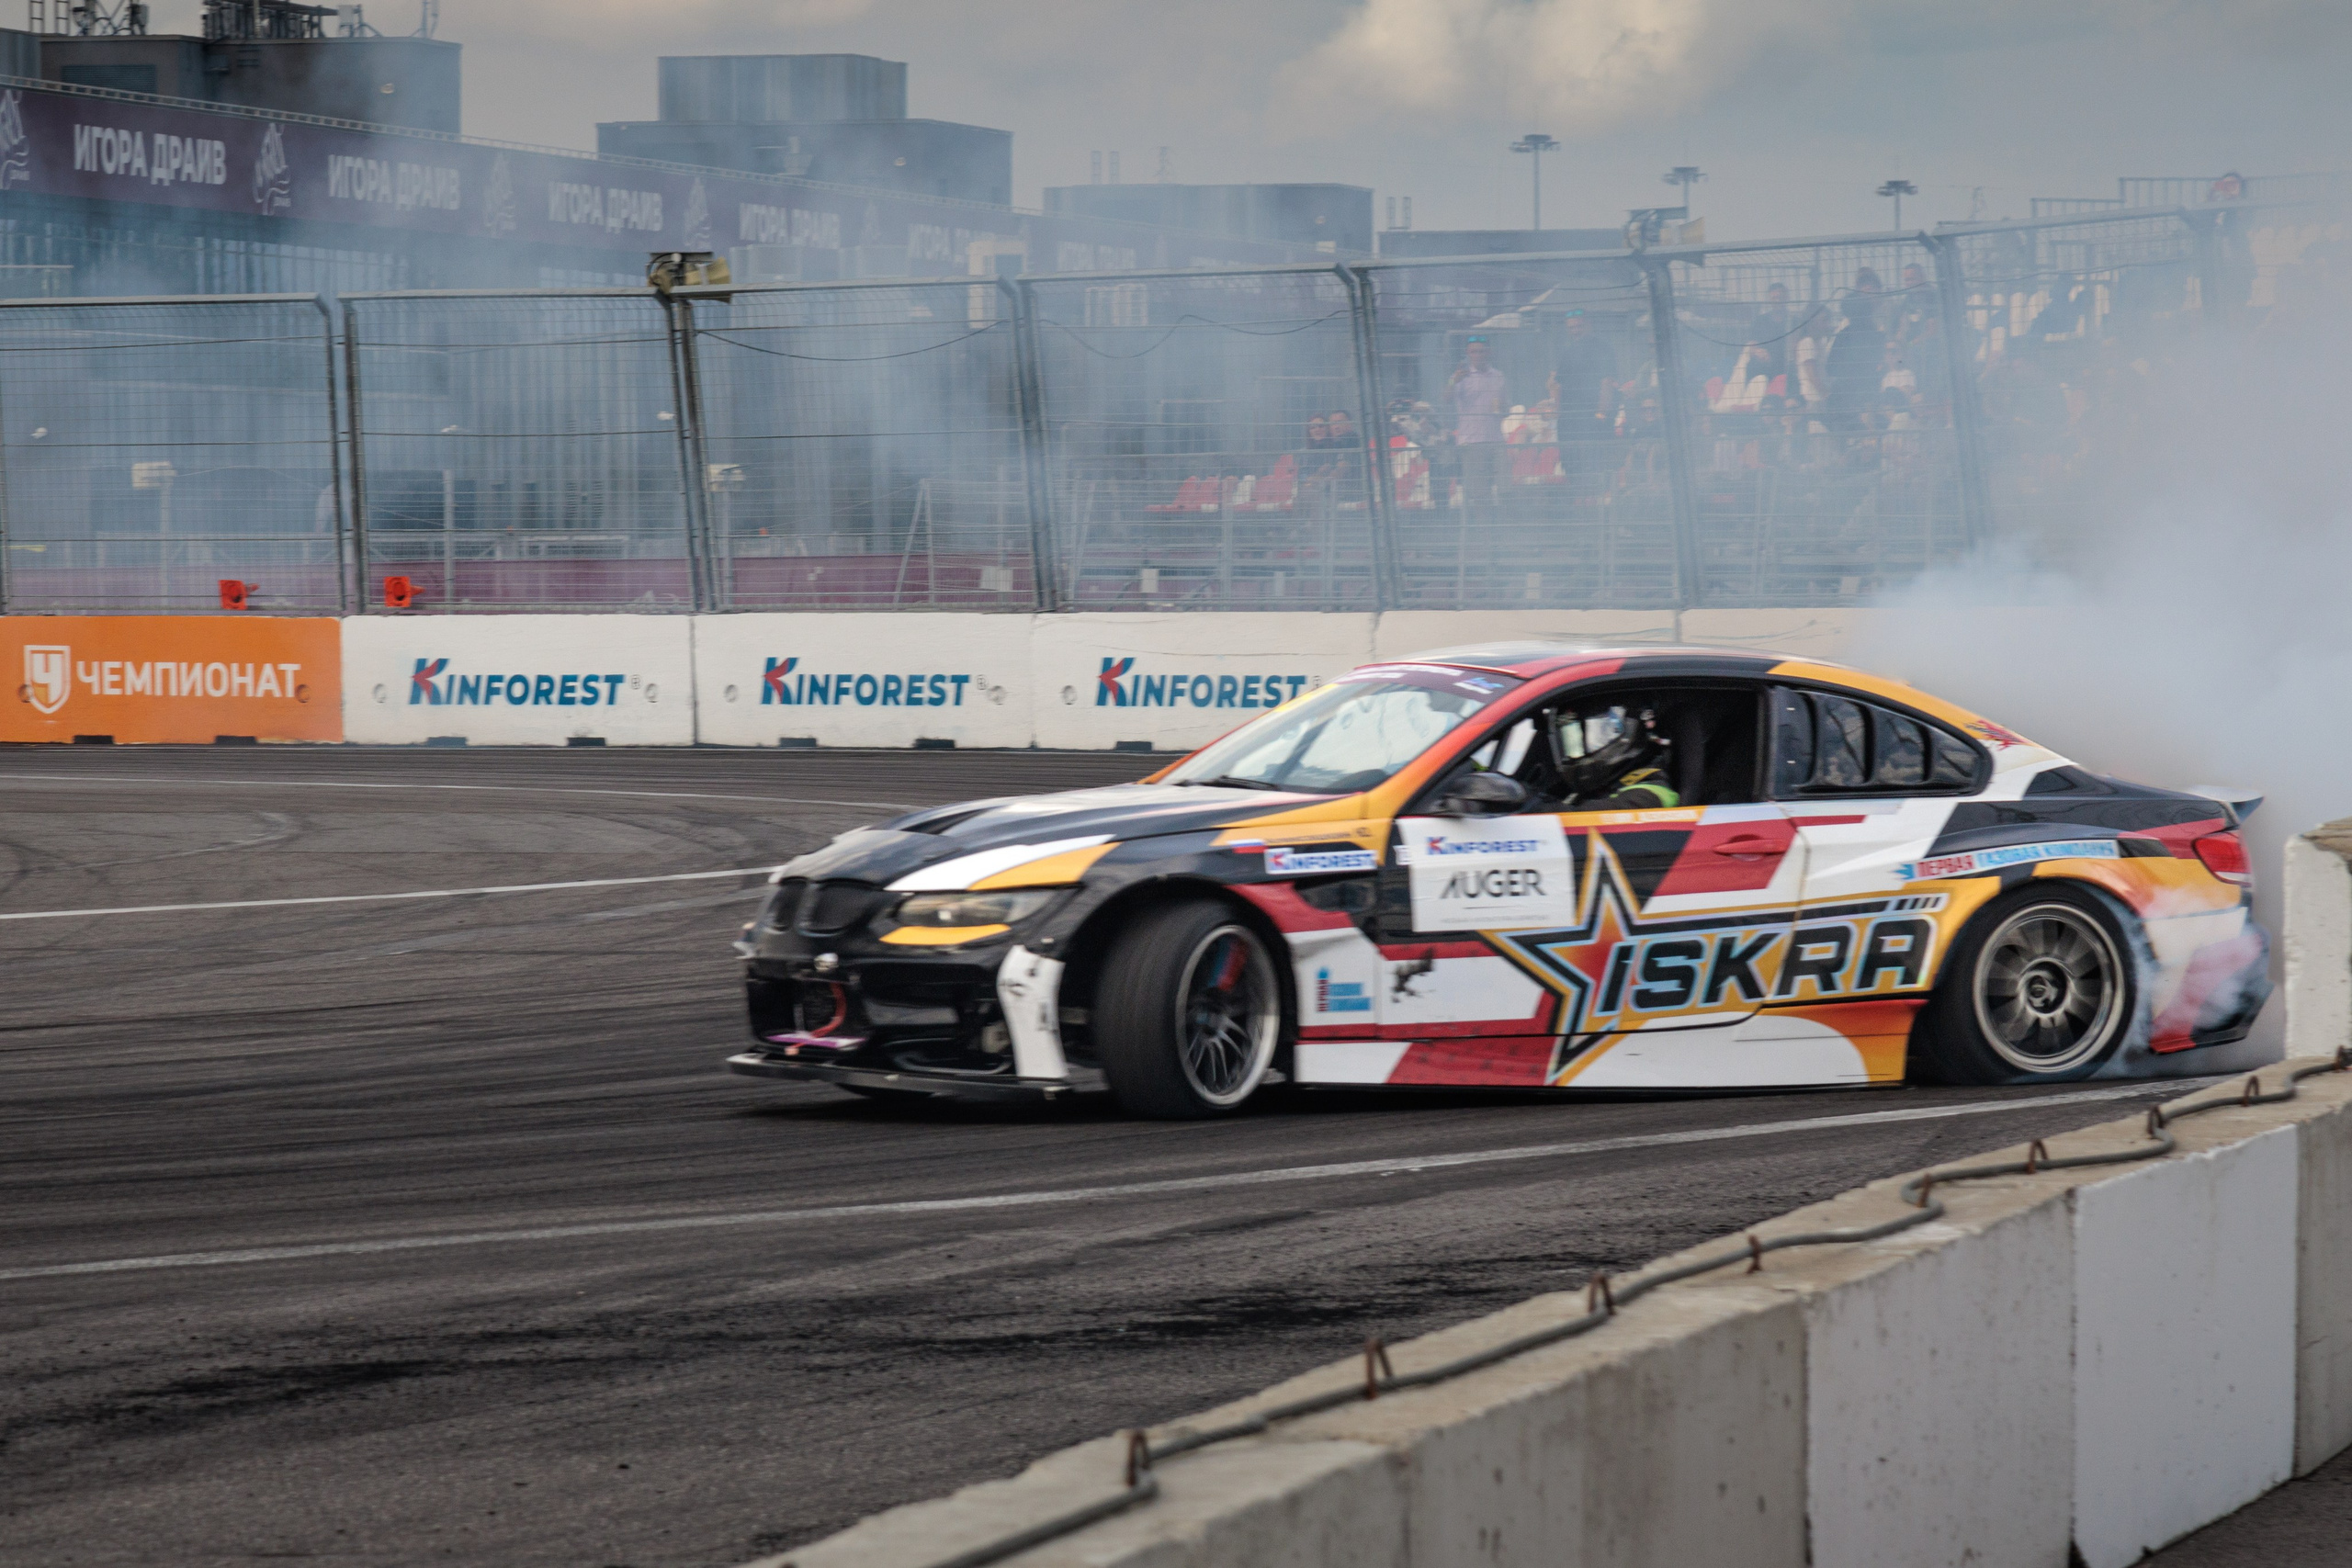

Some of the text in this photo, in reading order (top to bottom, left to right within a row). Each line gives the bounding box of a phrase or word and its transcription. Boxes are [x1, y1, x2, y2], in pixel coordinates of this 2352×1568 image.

[74, 123, 149, 177] ИГОРА
[328, 154, 392, 203] ИГОРА
[548, 181, 604, 226] ИГОРА
[76, 660, 301, 698] ЧЕМПИОНАТ
[409, 658, 625, 705] KINFOREST
[761, 657, 970, 706] KINFOREST
[1096, 657, 1306, 708] KINFOREST
[1426, 836, 1538, 855] KINFOREST
[1917, 854, 1974, 877] ПЕРВАЯ
[1439, 868, 1547, 898] AUGER
[1597, 917, 1936, 1016] ISKRA
